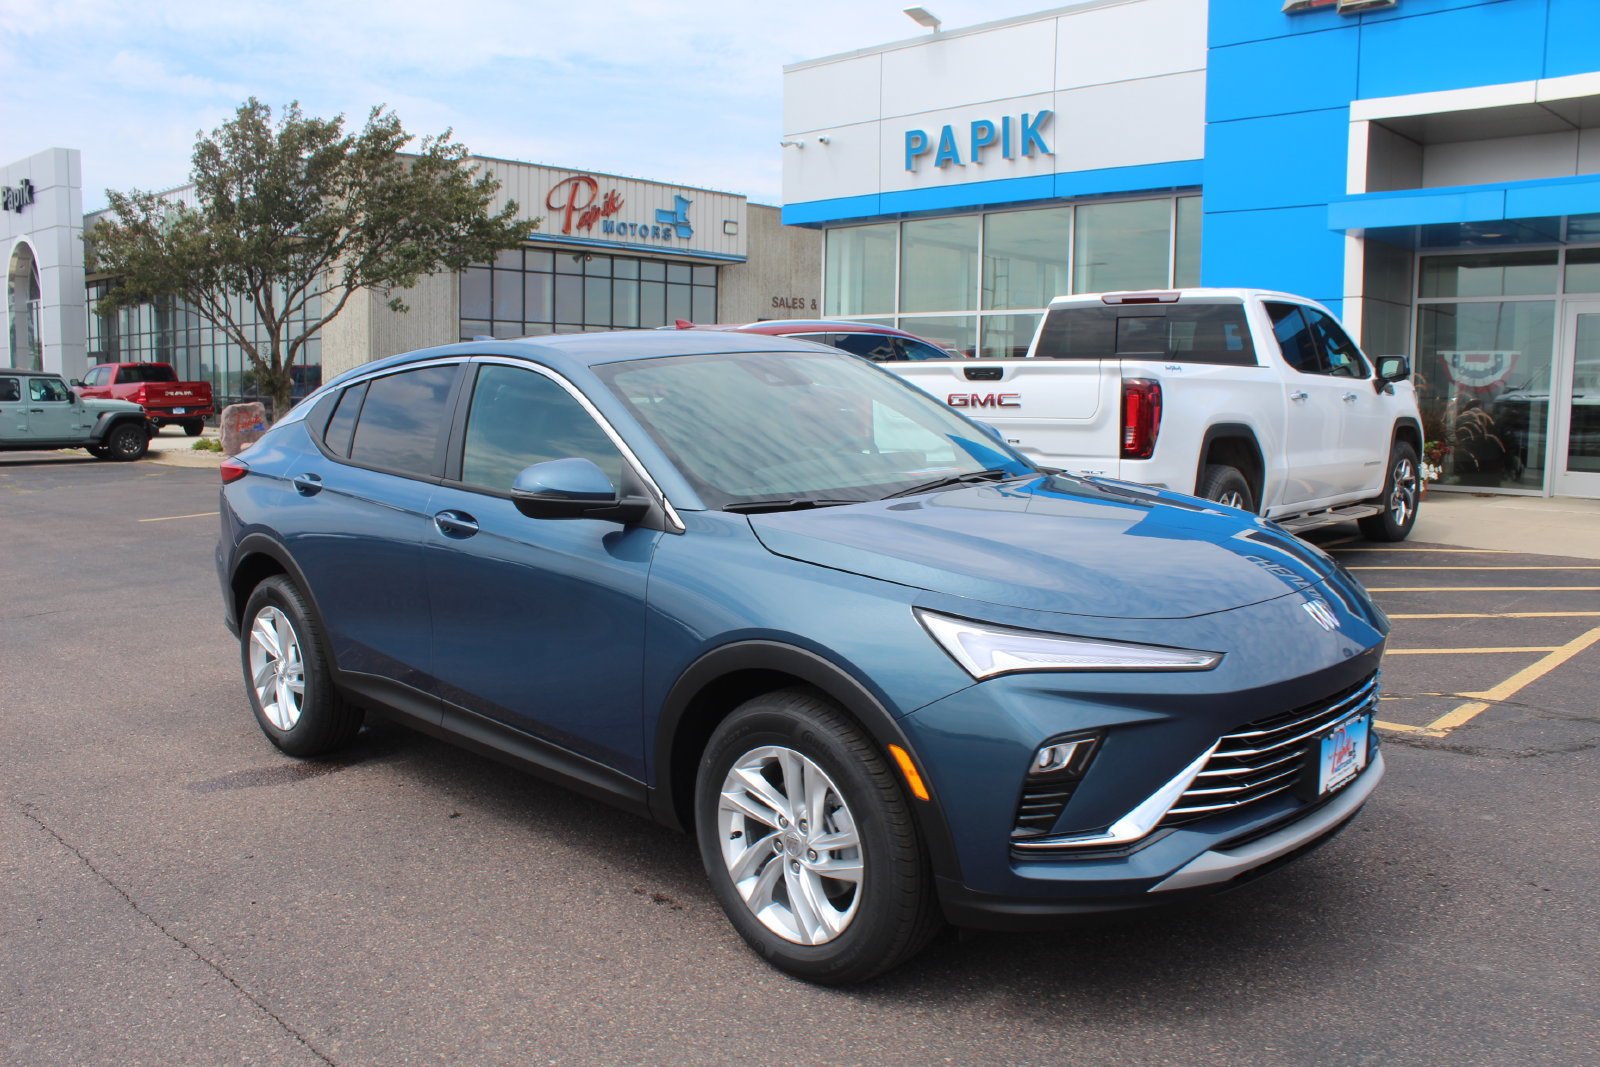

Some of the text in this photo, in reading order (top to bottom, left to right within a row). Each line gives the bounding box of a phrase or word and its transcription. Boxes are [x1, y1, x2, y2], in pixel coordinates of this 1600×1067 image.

[905, 110, 1054, 172] PAPIK
[1, 178, 34, 213] Papik
[603, 220, 672, 240] MOTORS
[772, 296, 817, 310] SALES &
[947, 393, 1021, 408] GMC
